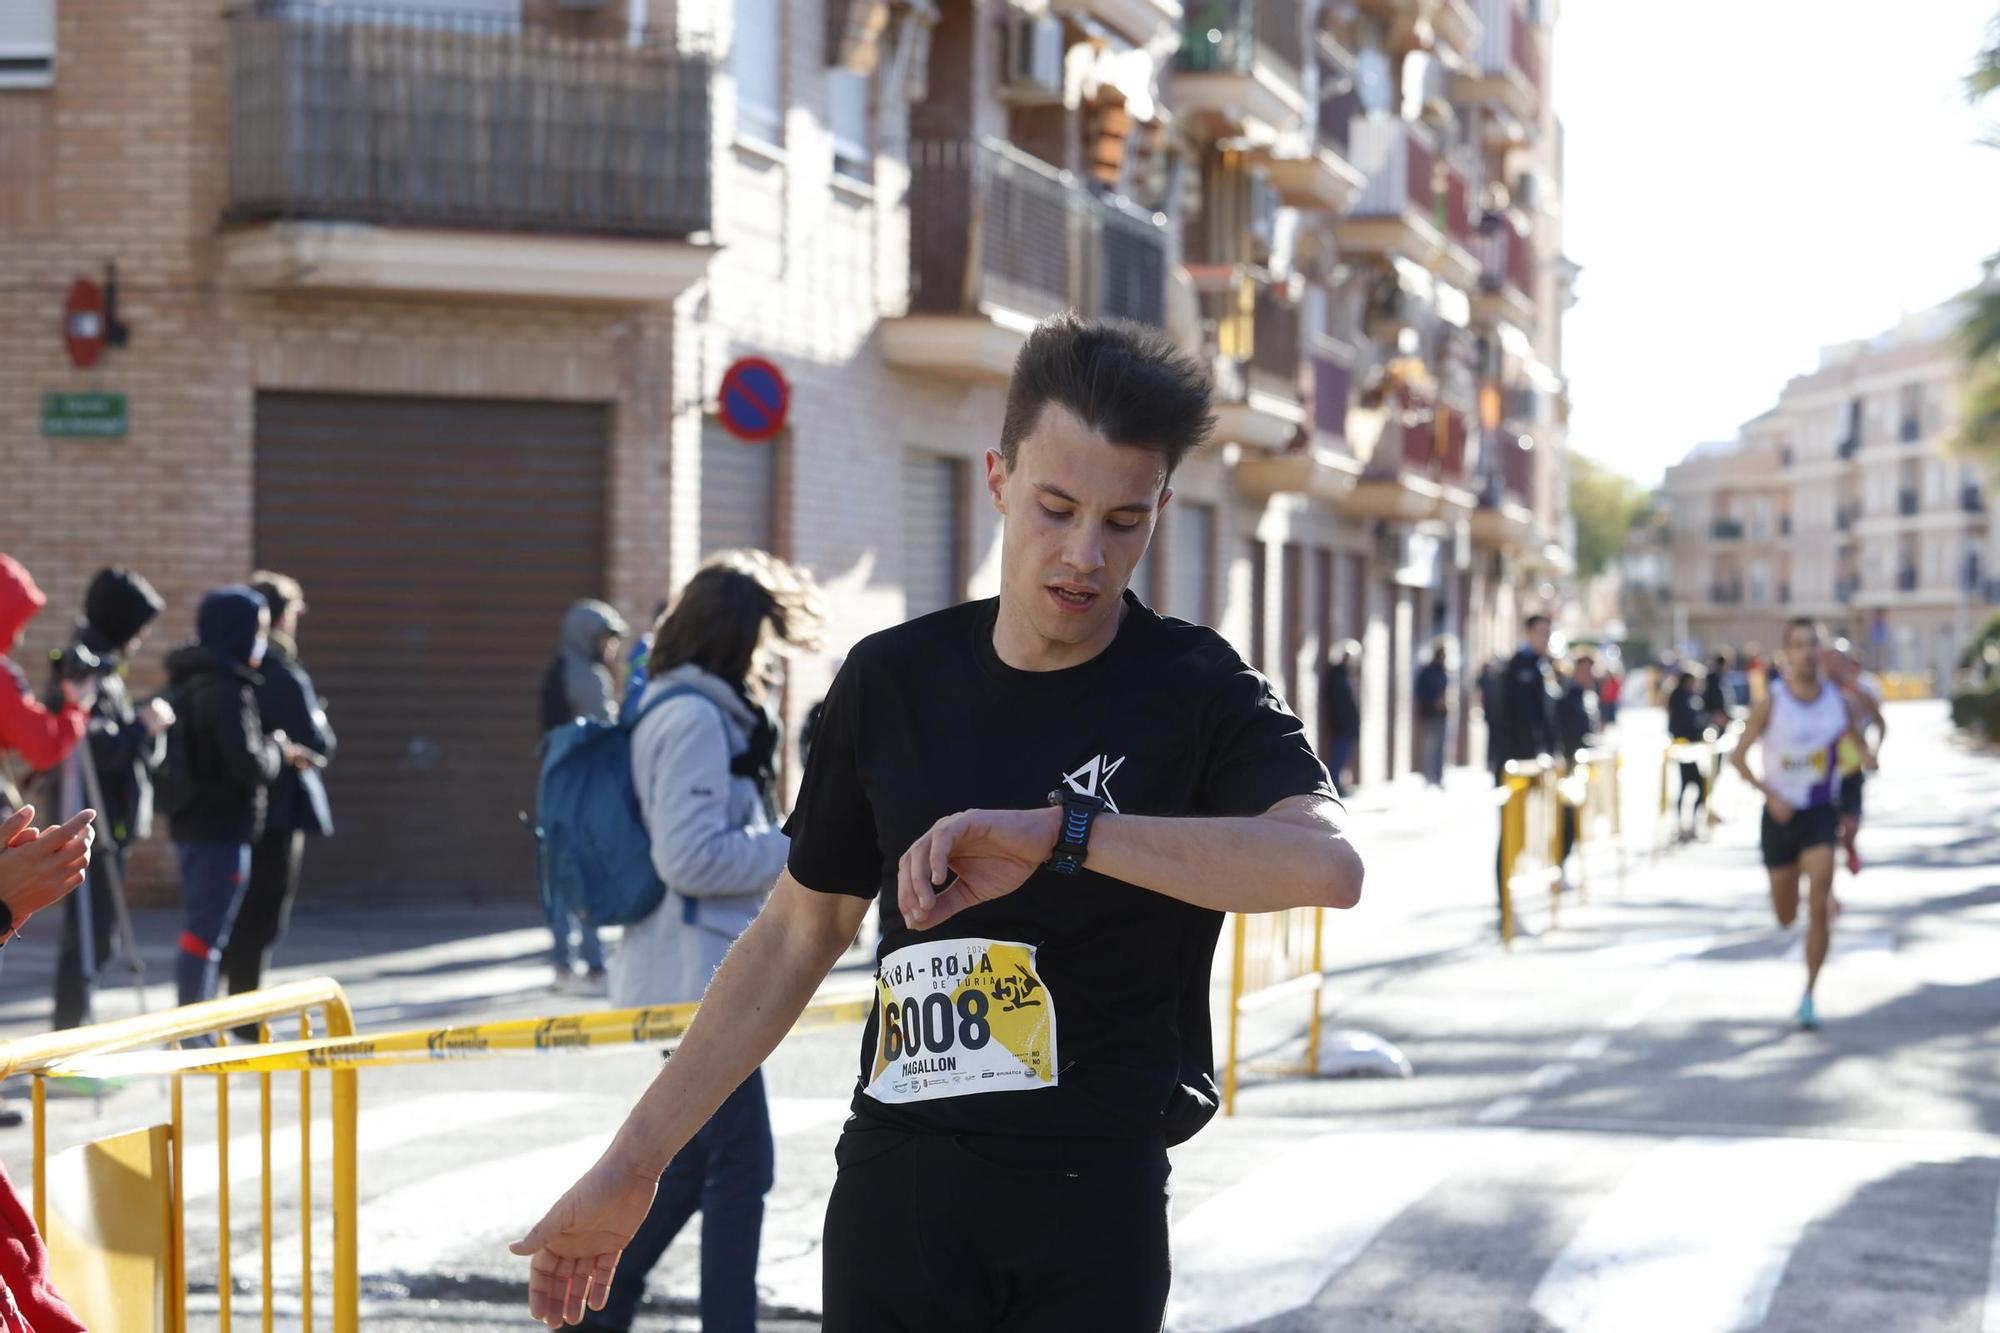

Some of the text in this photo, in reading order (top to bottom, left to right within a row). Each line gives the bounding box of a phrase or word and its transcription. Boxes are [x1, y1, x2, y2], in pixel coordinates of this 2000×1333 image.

[932, 980, 946, 990] DE
[884, 989, 991, 1062] 6008
[902, 1056, 957, 1078] MAGALLON
